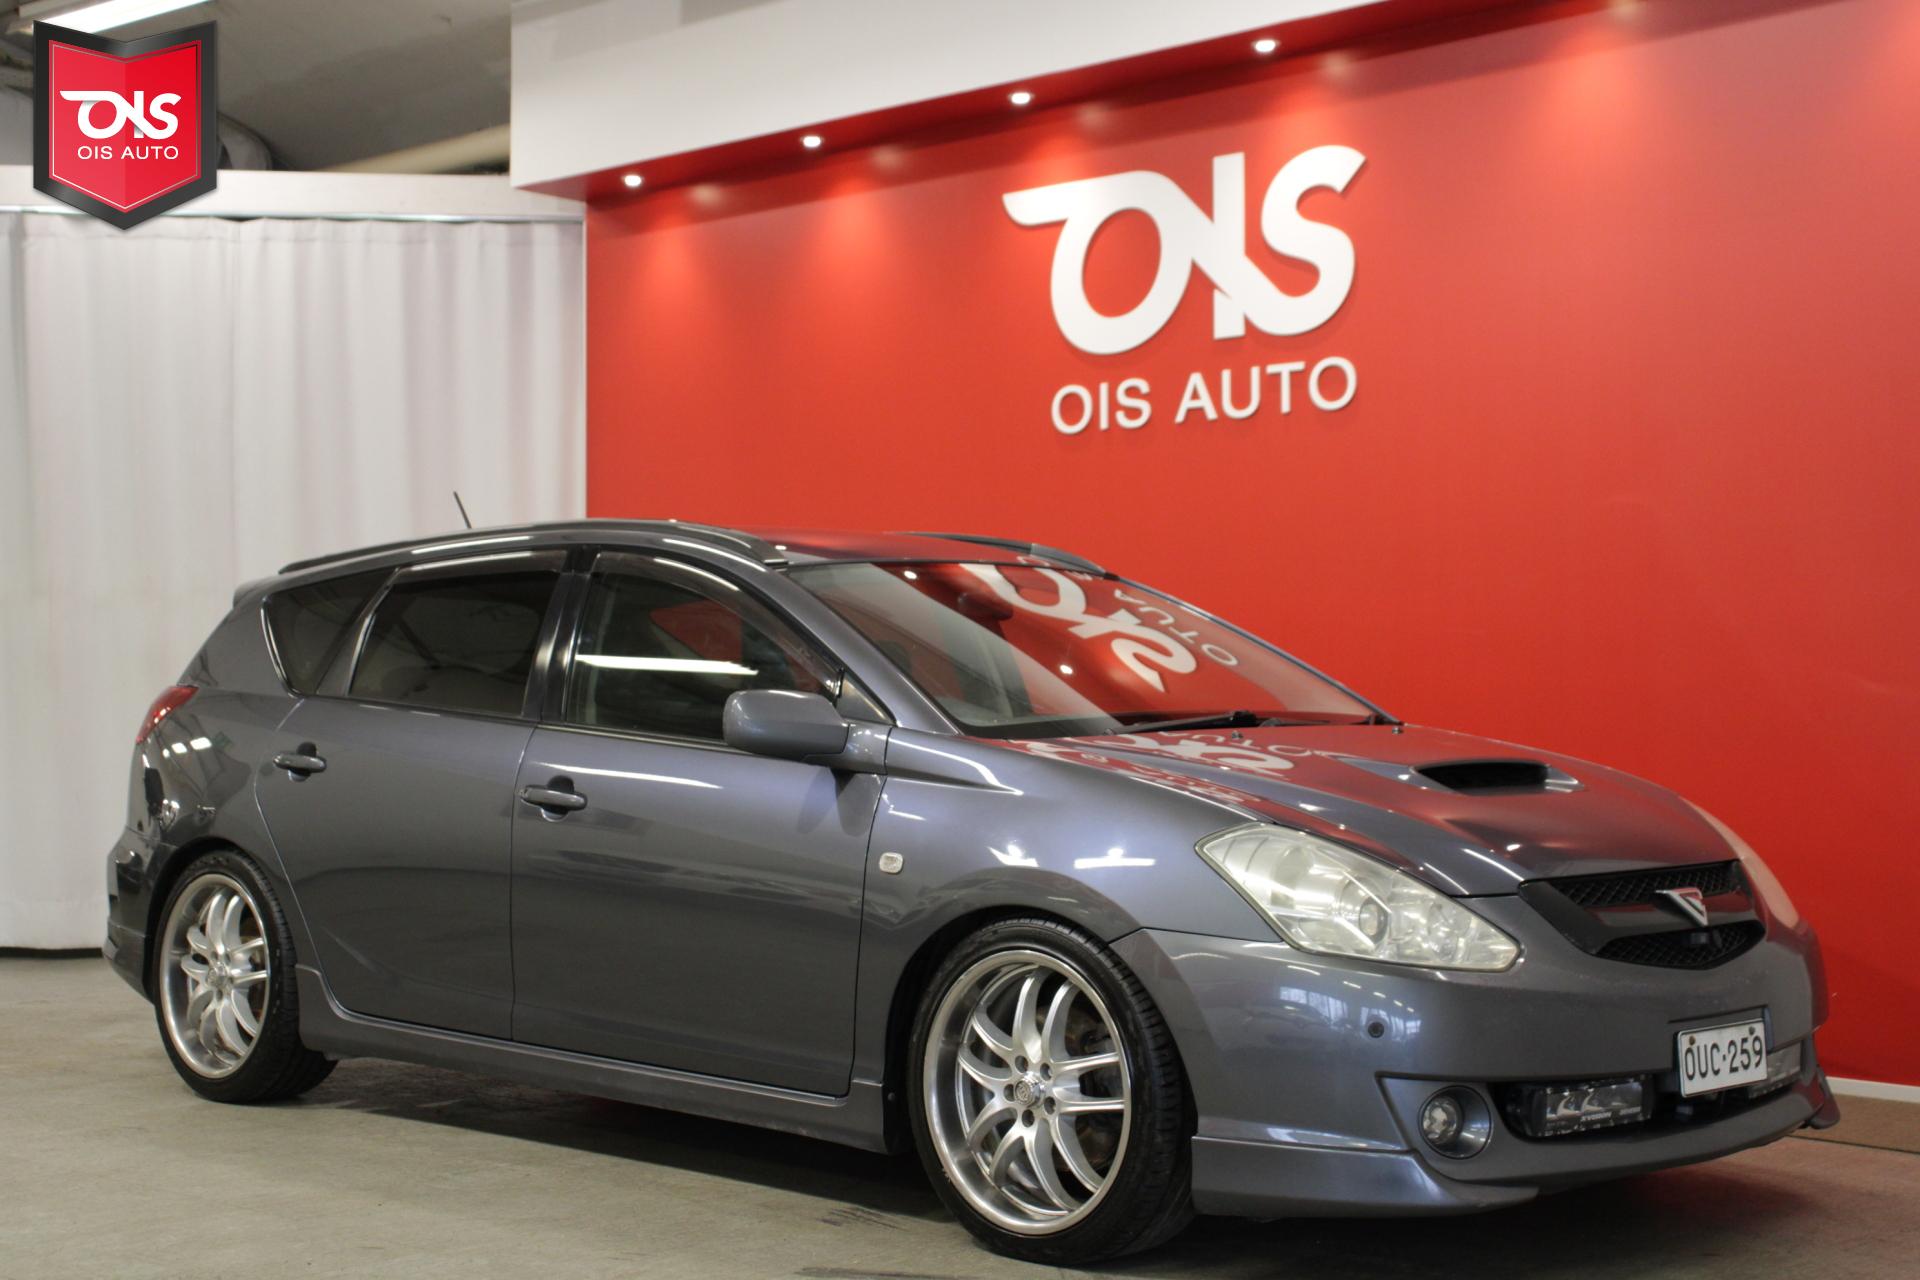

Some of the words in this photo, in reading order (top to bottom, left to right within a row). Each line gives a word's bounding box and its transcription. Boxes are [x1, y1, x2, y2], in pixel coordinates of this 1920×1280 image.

[1002, 145, 1366, 355] OIS
[1051, 378, 1152, 434] OIS
[1174, 356, 1357, 423] AUTO
